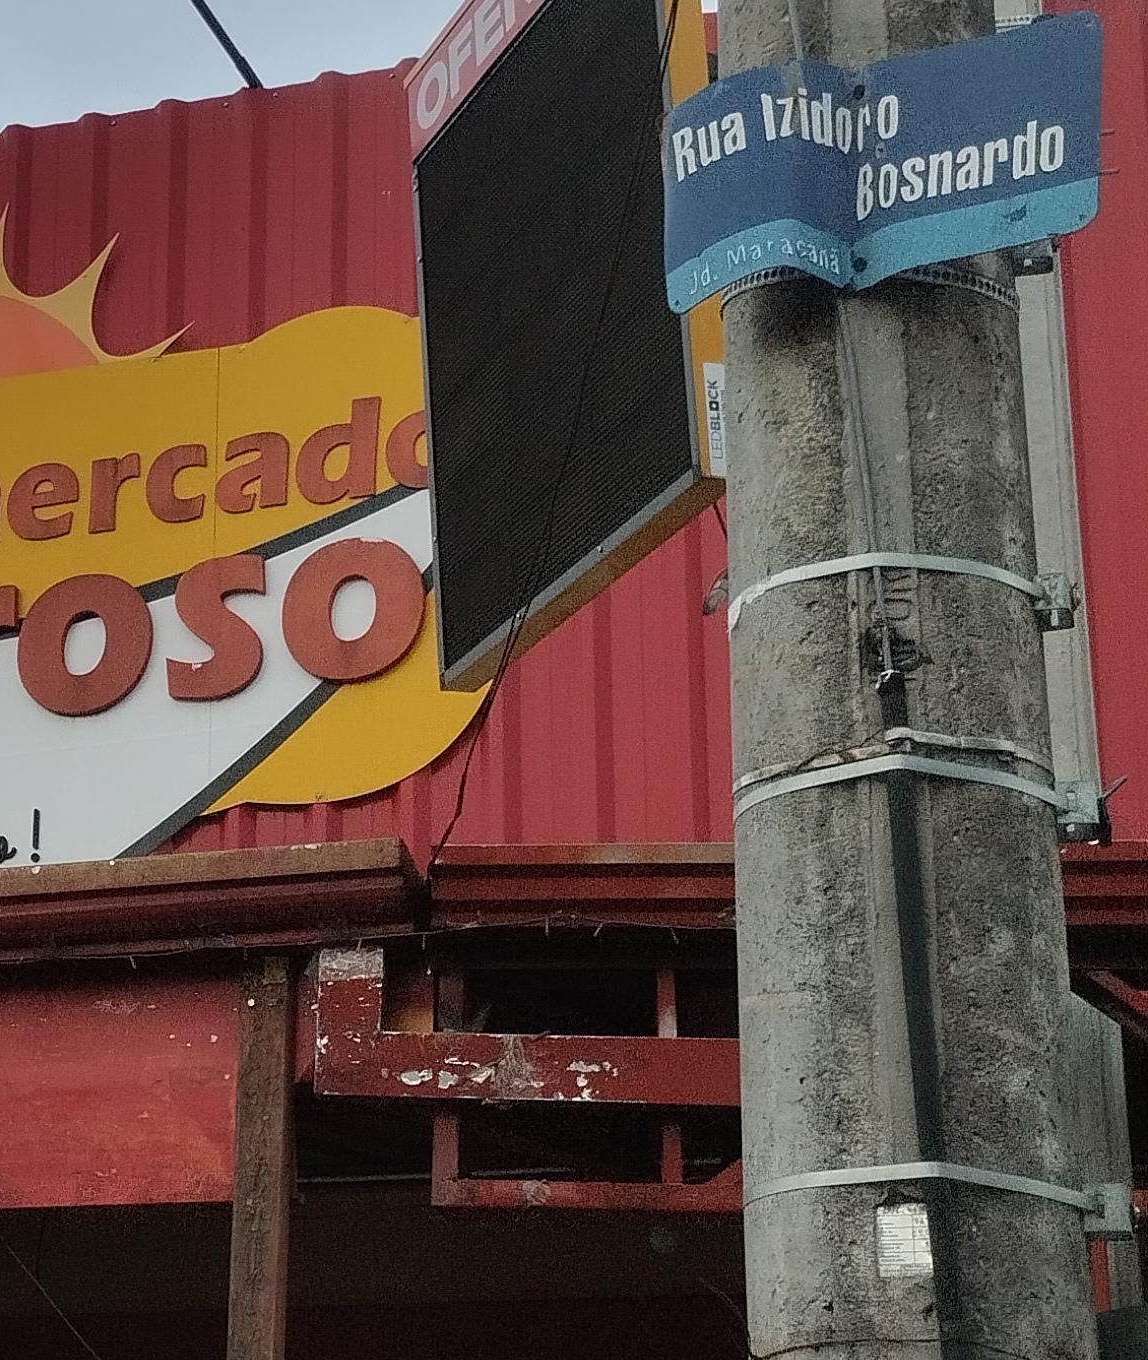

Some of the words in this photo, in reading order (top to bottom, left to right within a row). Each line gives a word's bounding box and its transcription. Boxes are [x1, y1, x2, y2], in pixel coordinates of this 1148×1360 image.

[671, 111, 747, 182] Rua
[760, 86, 900, 155] Izidoro
[855, 121, 1065, 222] Bosnardo
[689, 265, 719, 296] Jd.
[726, 236, 841, 276] Maracanã
[707, 379, 723, 460] LEDBLOCK
